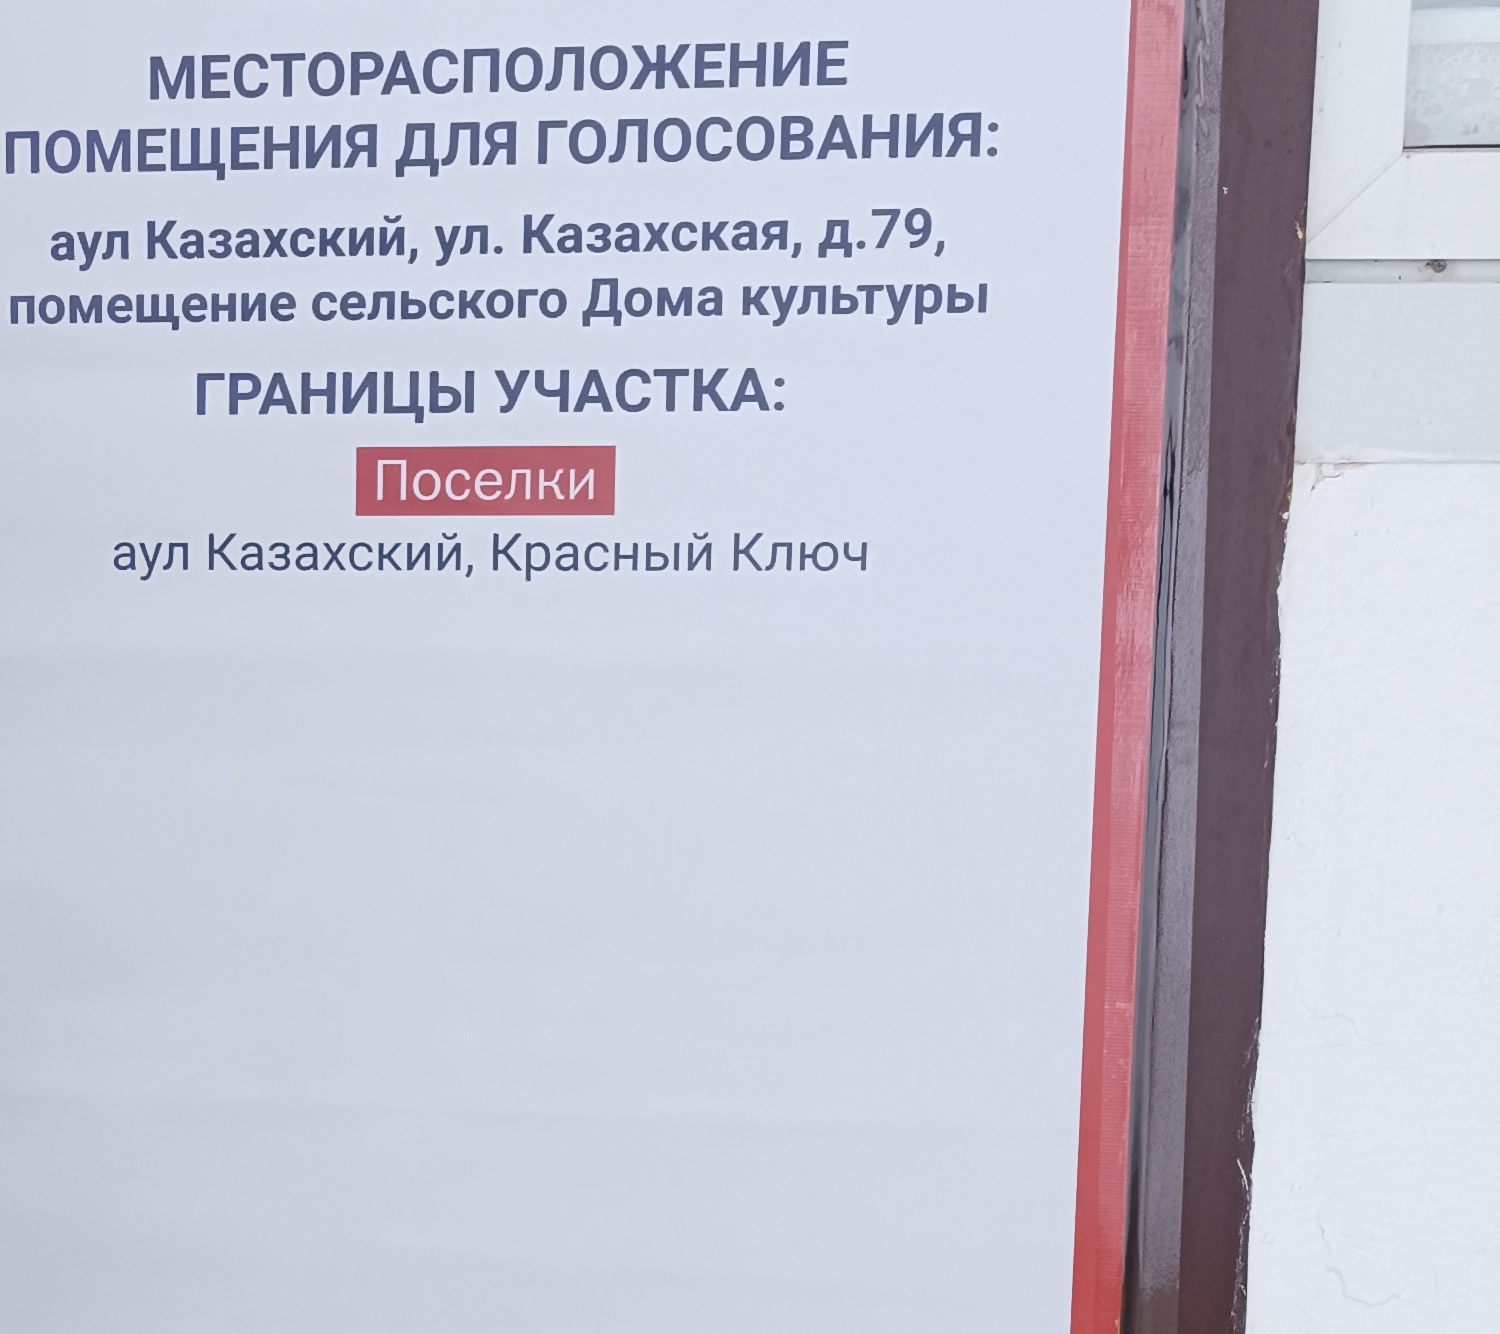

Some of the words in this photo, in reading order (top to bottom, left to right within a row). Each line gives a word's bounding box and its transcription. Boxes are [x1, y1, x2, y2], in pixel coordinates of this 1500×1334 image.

[149, 40, 849, 101] МЕСТОРАСПОЛОЖЕНИЕ
[5, 123, 378, 182] ПОМЕЩЕНИЯ
[394, 120, 518, 178] ДЛЯ
[537, 111, 999, 165] ГОЛОСОВАНИЯ:
[50, 230, 130, 272] аул
[146, 214, 418, 265] Казахский,
[434, 224, 504, 267] ул.
[522, 213, 802, 259] Казахская,
[817, 207, 945, 259] д.79,
[9, 291, 297, 332] помещение
[311, 287, 568, 322] сельского
[581, 277, 724, 328] Дома
[741, 282, 988, 327] культуры
[196, 370, 475, 424] ГРАНИЦЫ
[494, 367, 785, 414] УЧАСТКА:
[376, 459, 595, 501] Поселки
[113, 541, 189, 582] аул
[208, 532, 474, 578] Казахский,
[492, 532, 713, 582] Красный
[732, 532, 868, 572] Ключ
